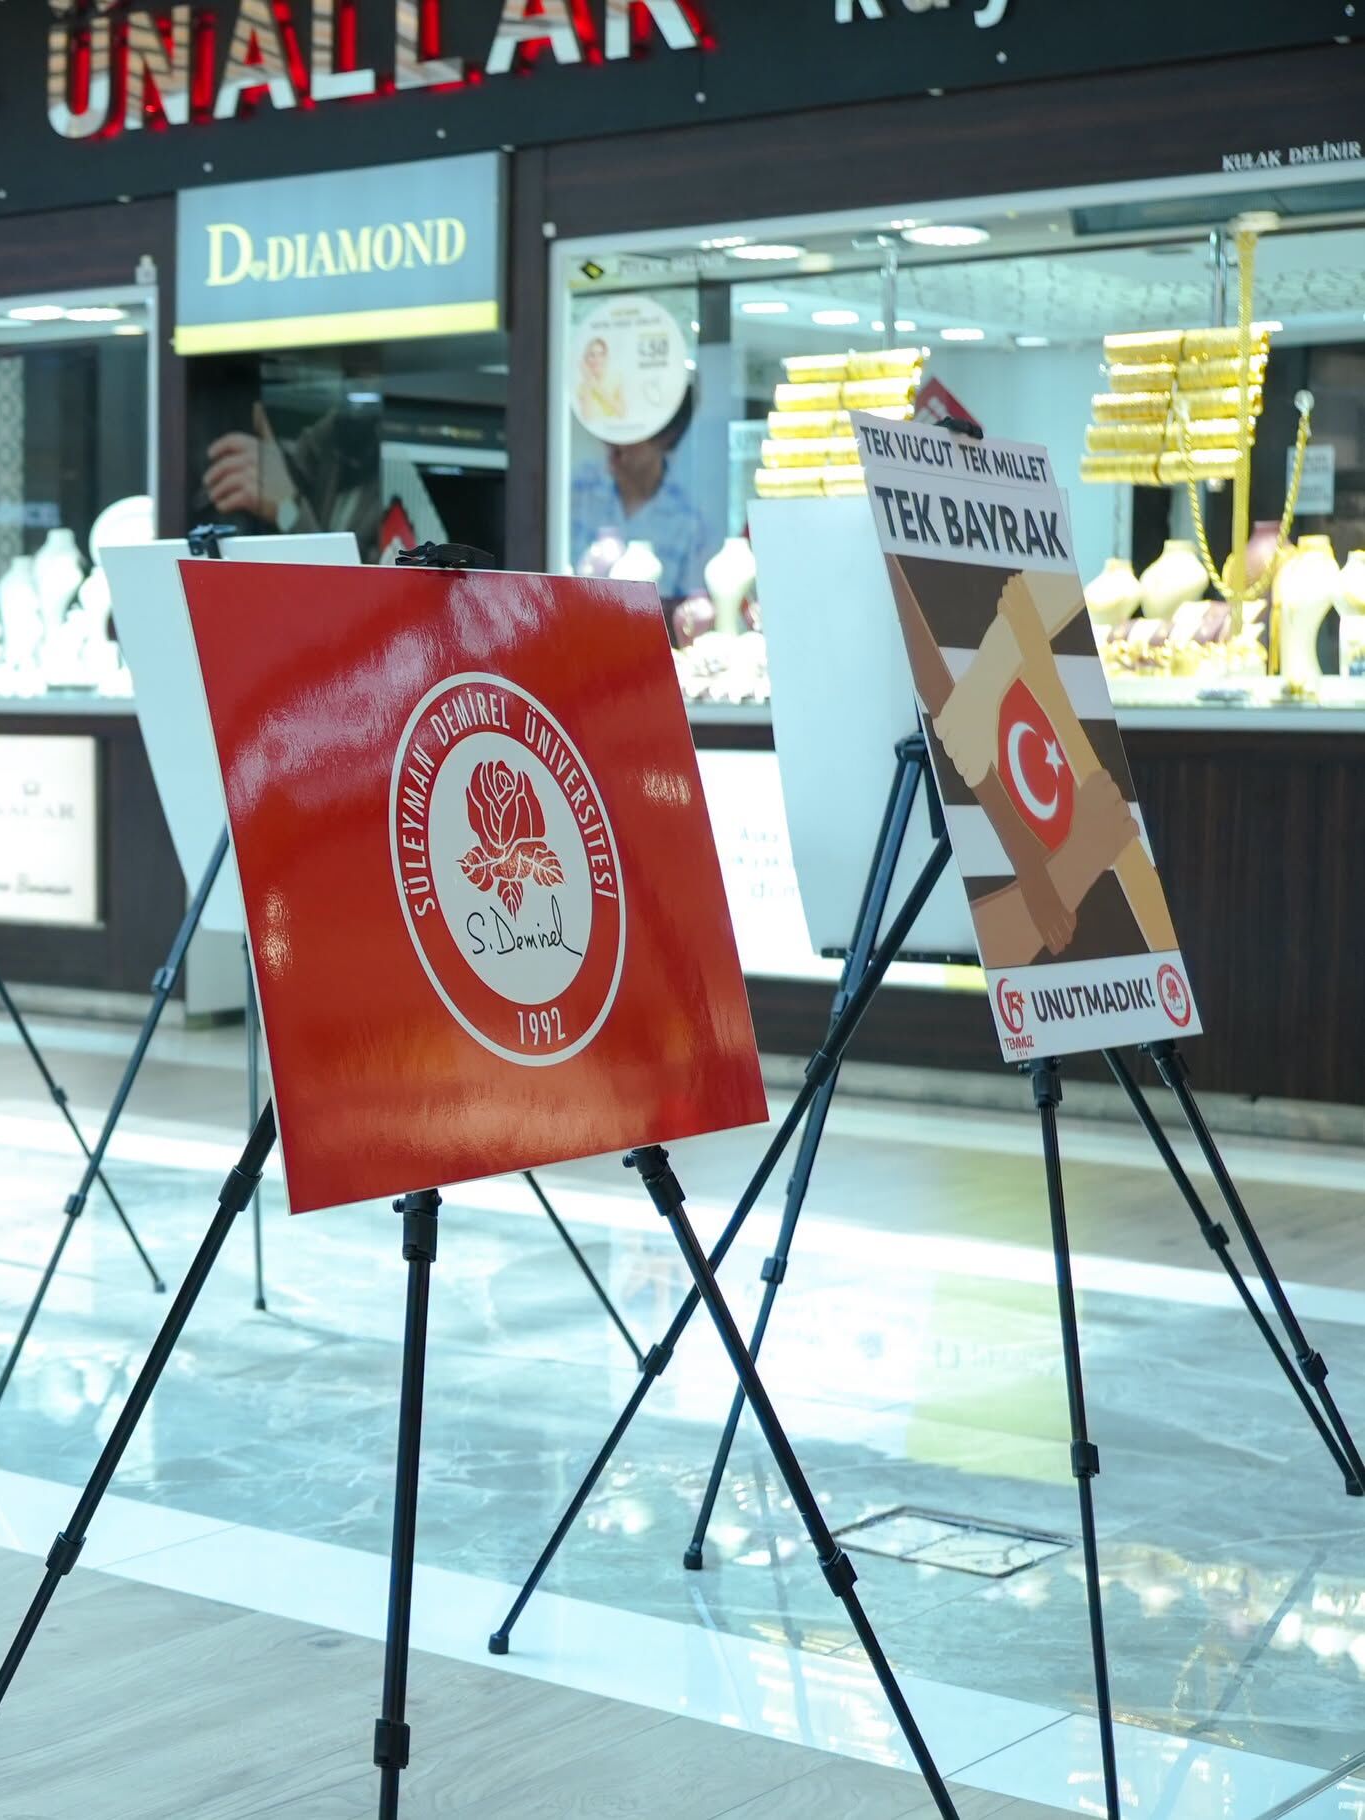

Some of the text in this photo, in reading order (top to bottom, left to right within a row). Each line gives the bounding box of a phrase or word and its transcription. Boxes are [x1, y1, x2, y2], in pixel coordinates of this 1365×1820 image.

[1221, 139, 1363, 172] KULAK DELİNİR
[860, 426, 1048, 484] TEK VÜCUT TEK MİLLET
[874, 485, 1068, 560] TEK BAYRAK
[402, 688, 617, 917] SÜLEYMAN DEMİREL ÜNİVERSİTESİ
[1031, 978, 1156, 1023] UNUTMADIK!
[517, 1007, 567, 1046] 1992
[1004, 1035, 1035, 1049] TEMMUZ
